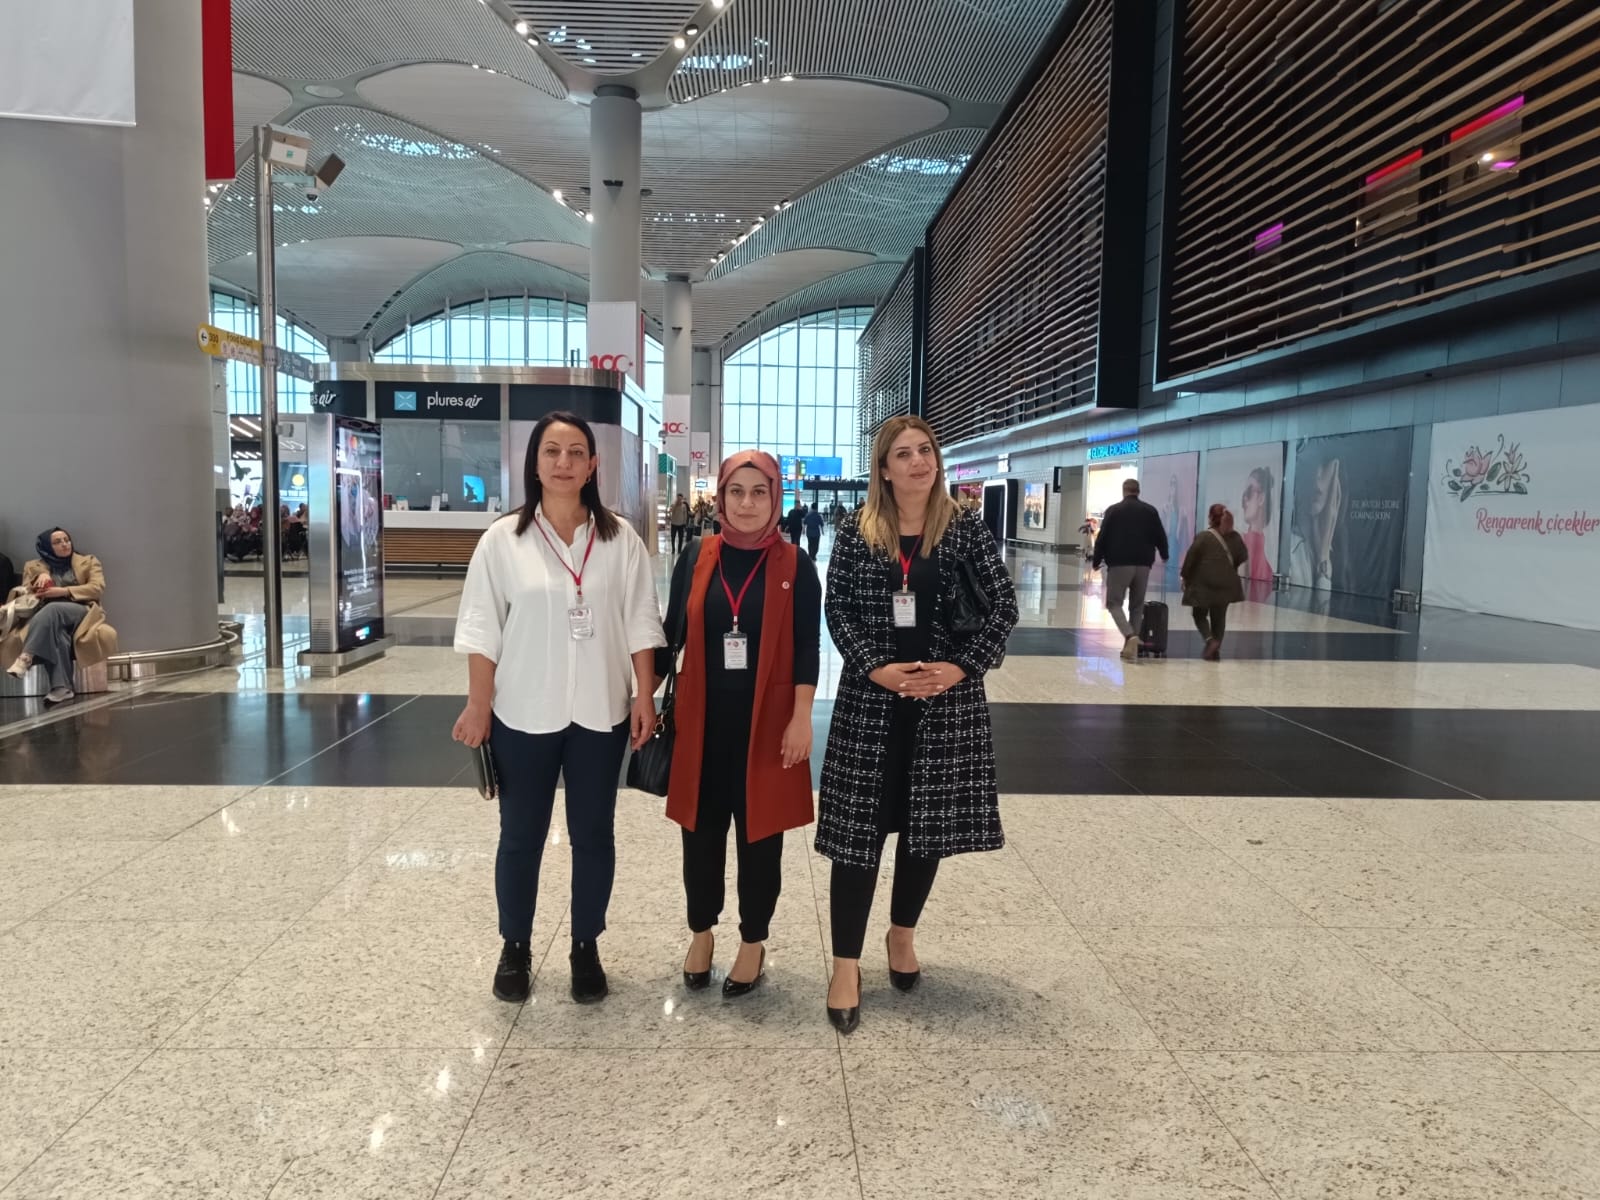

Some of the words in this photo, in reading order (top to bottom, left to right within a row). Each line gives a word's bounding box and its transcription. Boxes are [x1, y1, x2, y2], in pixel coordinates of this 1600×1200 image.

[589, 354, 630, 371] 100
[319, 390, 336, 407] air
[427, 391, 464, 409] plures
[465, 394, 483, 408] air
[1350, 511, 1374, 520] COMING
[1375, 511, 1391, 520] SOON
[1476, 507, 1546, 537] Rengarenk
[1546, 510, 1600, 536] çiçekler
